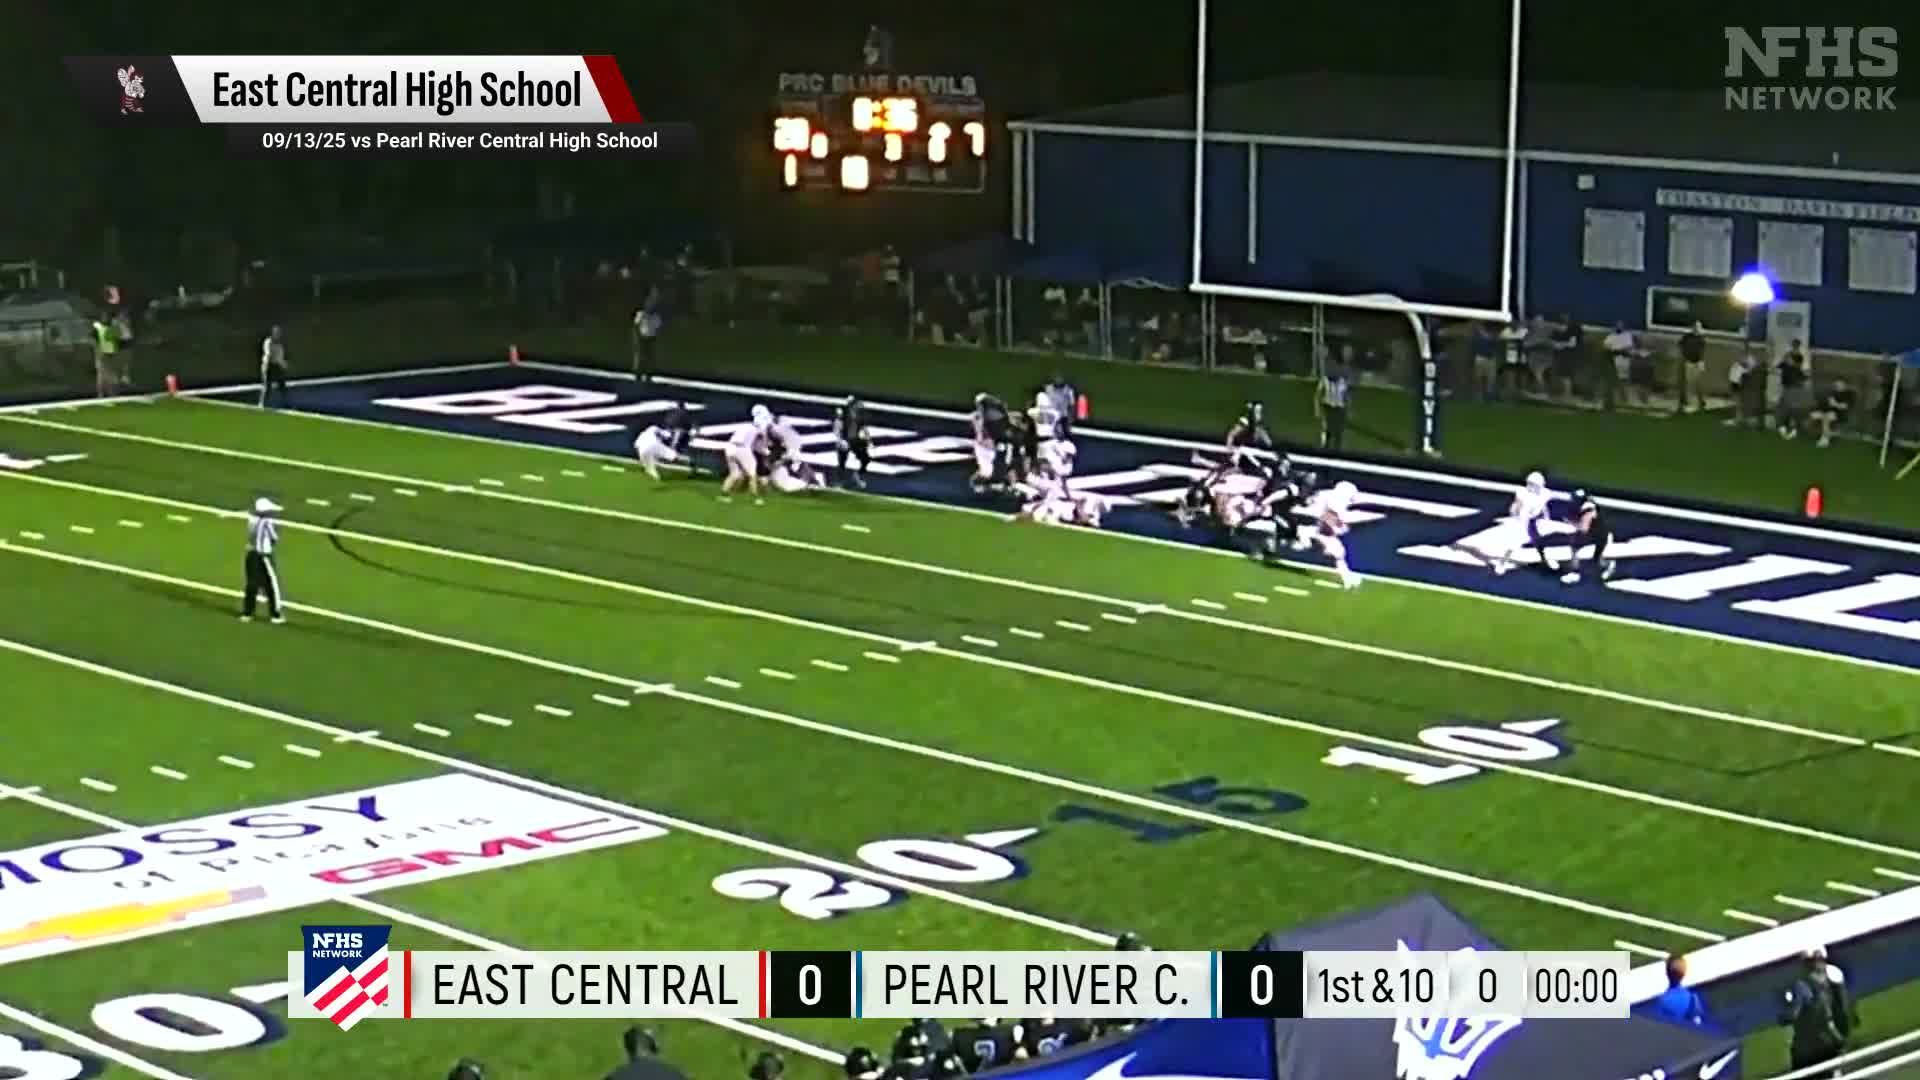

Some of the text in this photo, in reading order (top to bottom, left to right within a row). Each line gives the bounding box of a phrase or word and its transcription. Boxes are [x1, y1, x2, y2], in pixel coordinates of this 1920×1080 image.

[779, 73, 976, 97] PRC BLUE DEVILS
[1320, 726, 1560, 786] 10
[1048, 775, 1308, 844] 15
[309, 817, 641, 884] GMC
[711, 839, 1015, 919] 20
[0, 993, 267, 1080] 0
